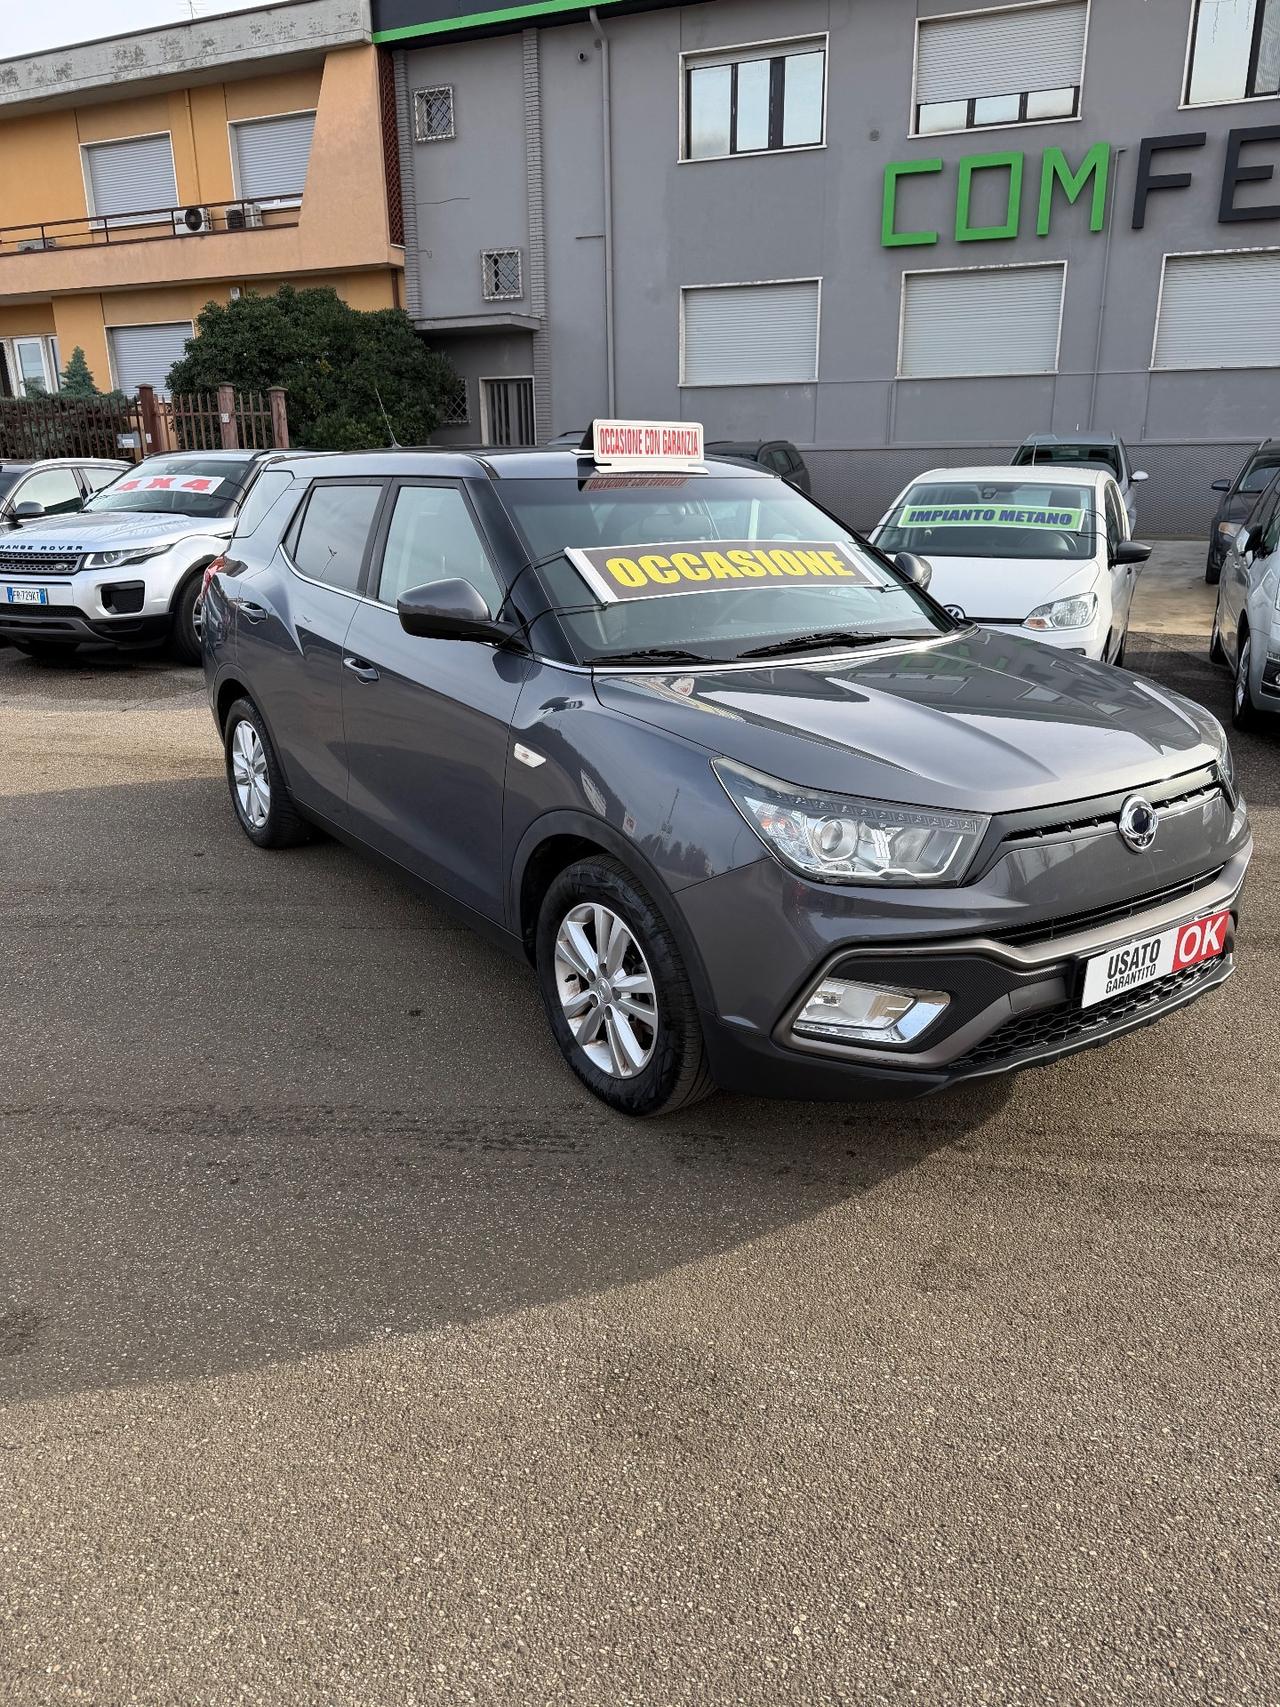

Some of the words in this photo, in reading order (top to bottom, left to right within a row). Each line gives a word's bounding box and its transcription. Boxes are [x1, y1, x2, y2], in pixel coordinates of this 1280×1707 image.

[600, 428, 643, 455] OCCASIONE
[645, 429, 660, 456] CON
[662, 430, 699, 456] GARANZIA
[908, 509, 996, 523] IMPIANTO
[1000, 510, 1073, 526] METANO
[606, 549, 855, 588] OCCASIONE
[1179, 914, 1225, 963] OK
[1107, 939, 1162, 980] USATO
[1105, 963, 1156, 994] GARANTITO
